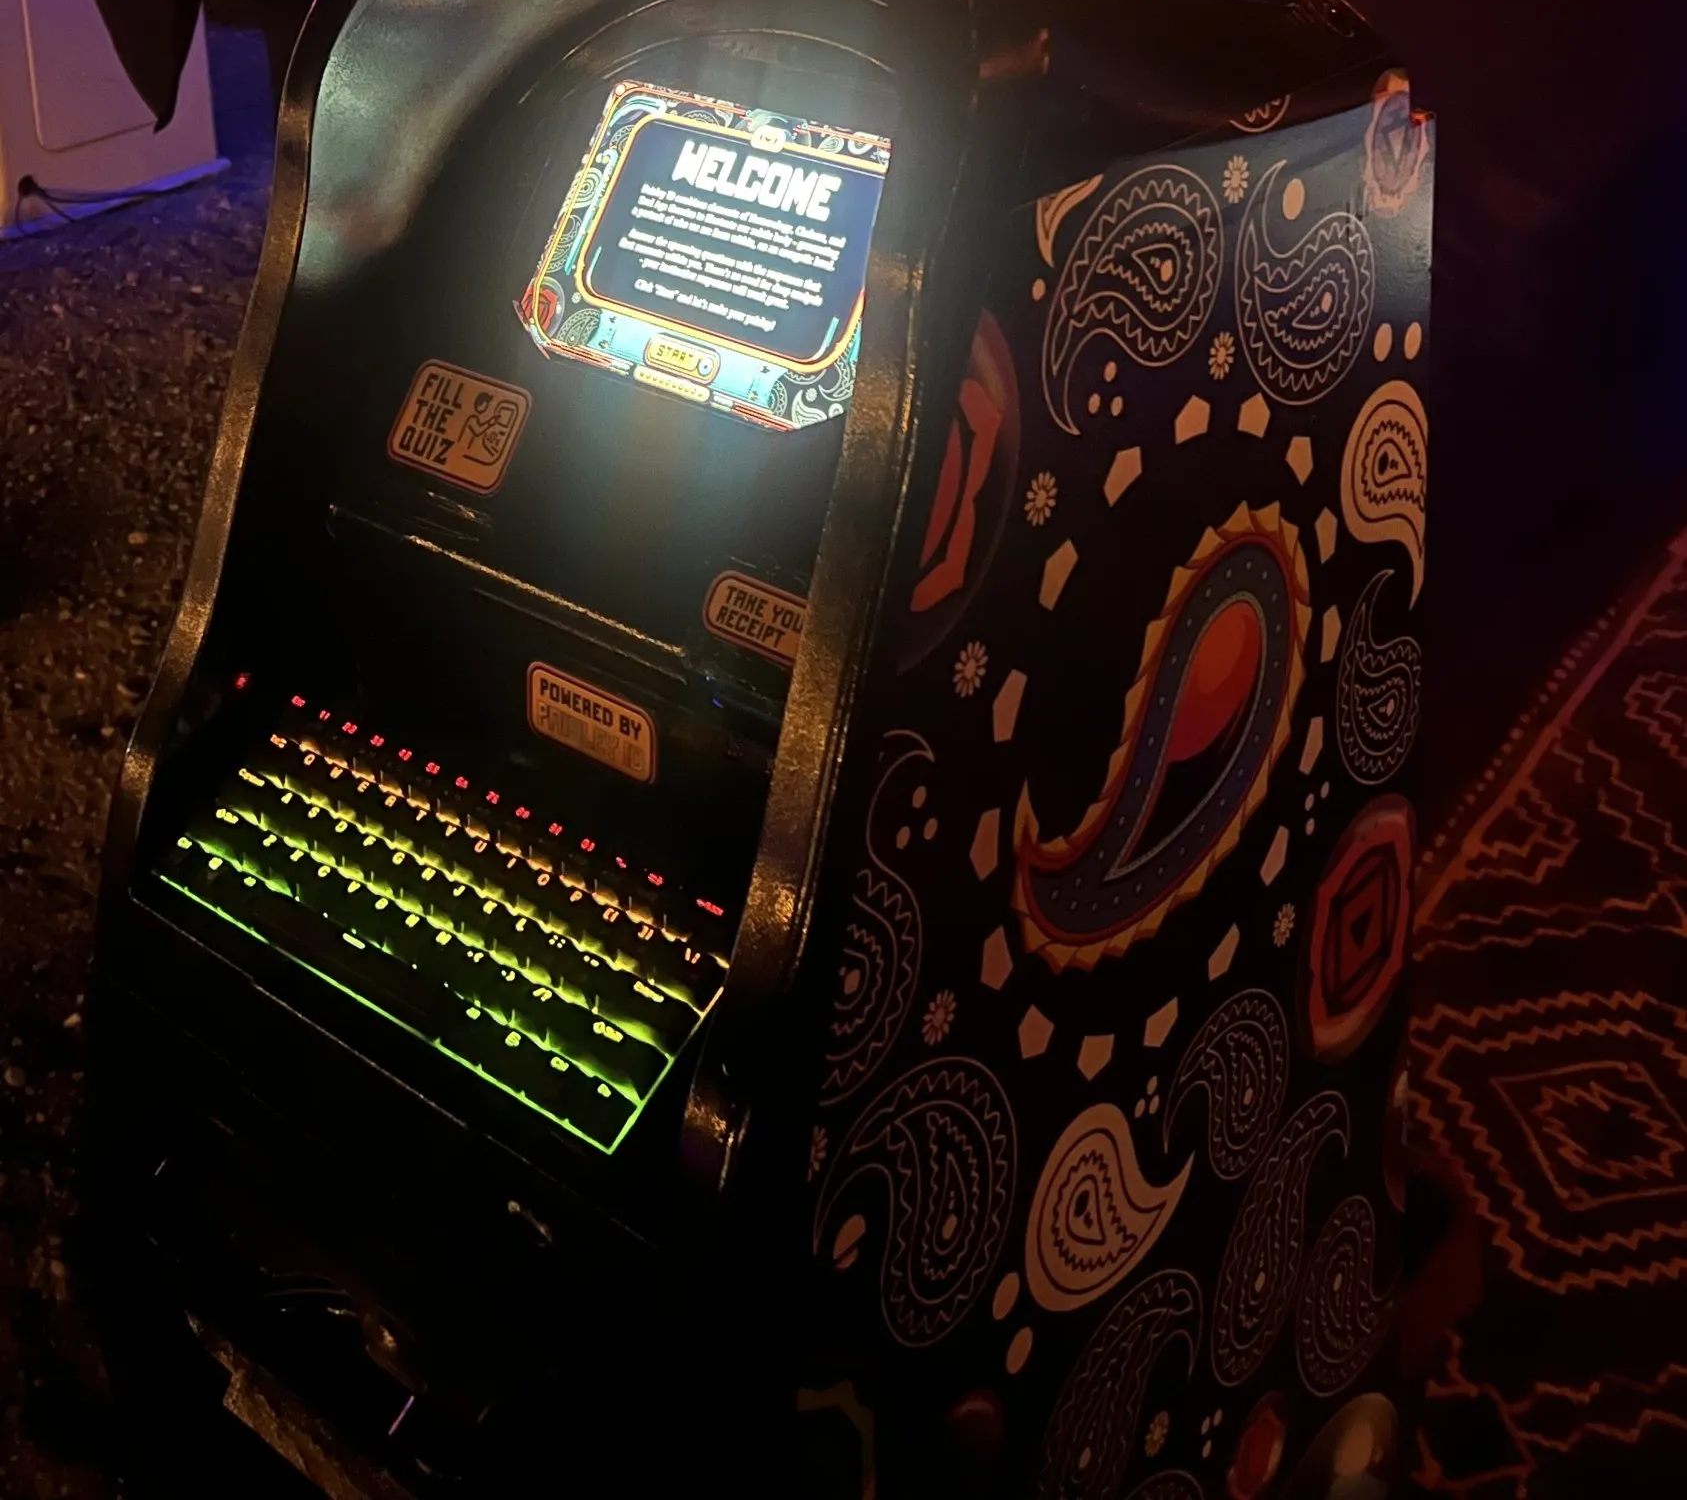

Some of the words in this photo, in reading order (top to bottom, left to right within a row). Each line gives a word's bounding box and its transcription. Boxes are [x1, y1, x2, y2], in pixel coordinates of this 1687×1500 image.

[671, 138, 843, 223] WELCOME
[656, 344, 694, 364] START
[420, 372, 464, 409] FILL
[412, 398, 454, 435] THE
[398, 424, 456, 466] QUIZ
[715, 605, 787, 648] RECEIPT
[725, 585, 768, 618] TAKE
[771, 604, 804, 634] YOU
[540, 677, 614, 728] POWERED
[619, 713, 642, 741] BY
[415, 809, 428, 821] T
[474, 839, 488, 853] U
[392, 851, 406, 865] G
[453, 885, 466, 897] J
[515, 917, 527, 932] L
